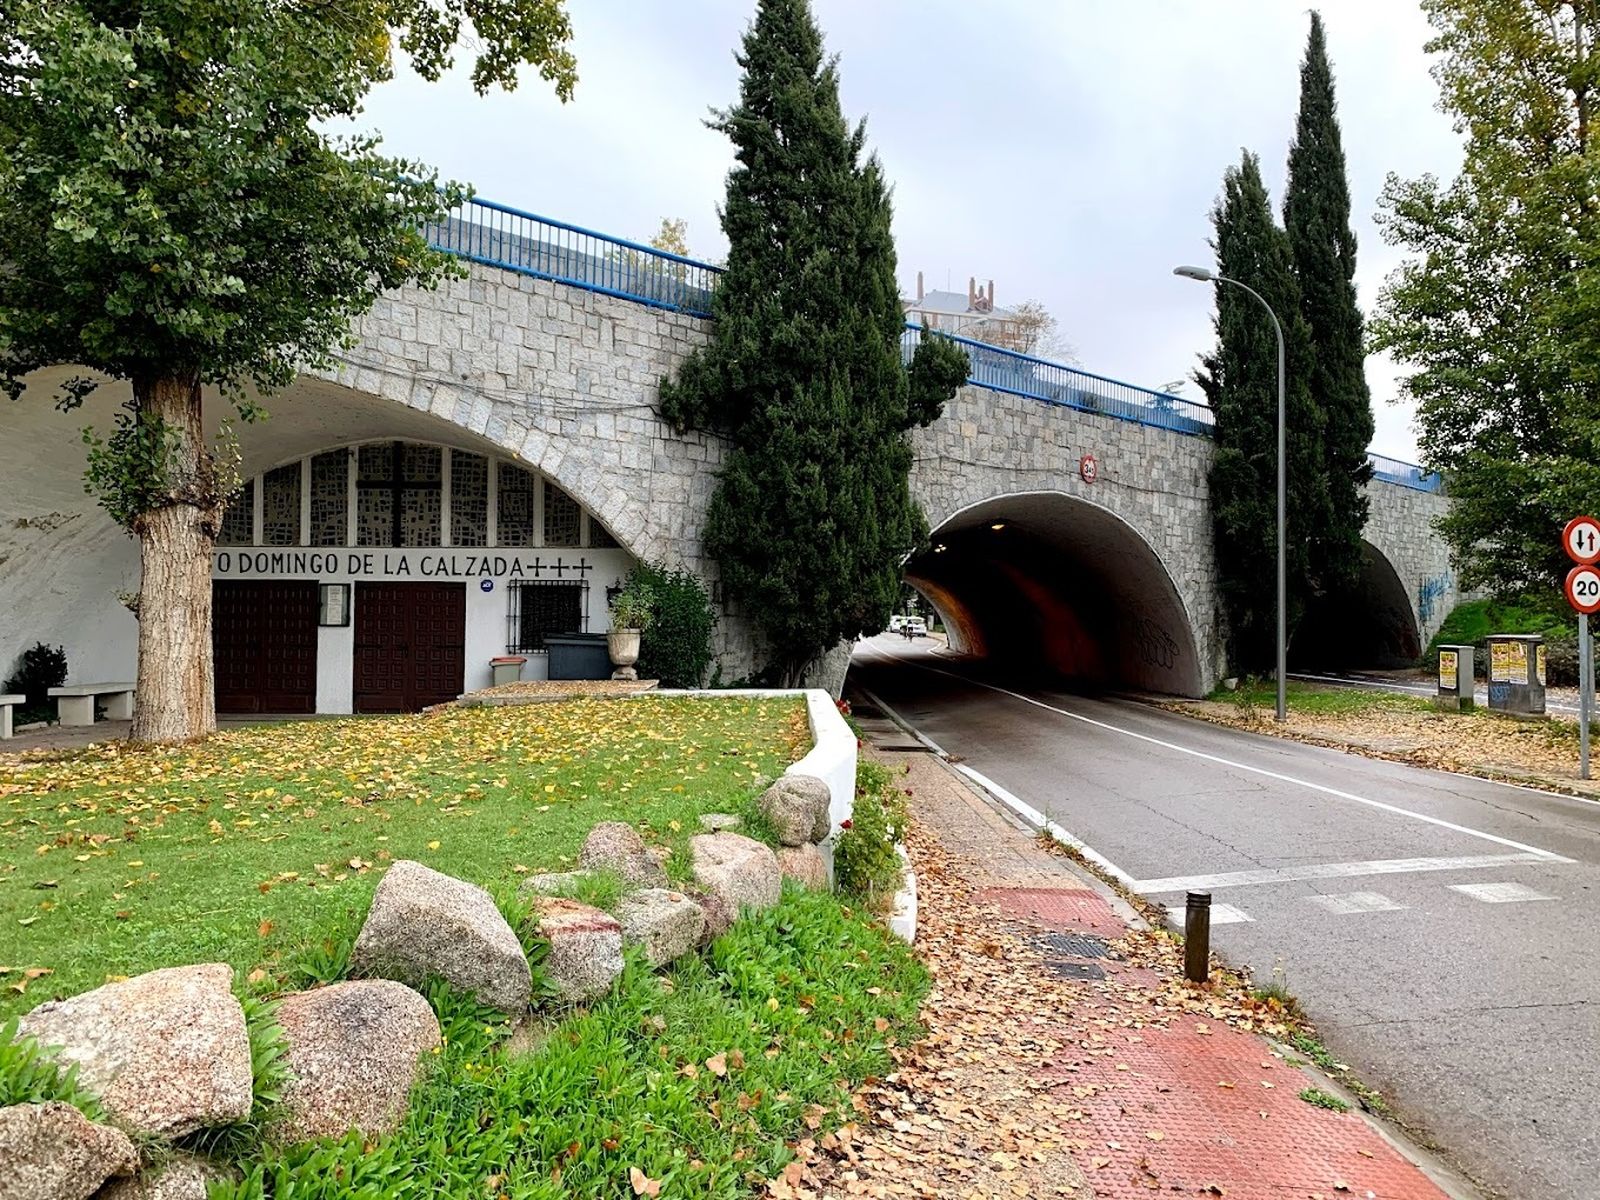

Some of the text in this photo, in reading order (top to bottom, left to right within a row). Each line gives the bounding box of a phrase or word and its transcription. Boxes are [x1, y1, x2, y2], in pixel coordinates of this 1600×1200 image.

[238, 552, 338, 574] DOMINGO
[347, 554, 374, 575] DE
[384, 555, 411, 576] LA
[420, 556, 524, 577] CALZADA
[1576, 580, 1599, 596] 20
